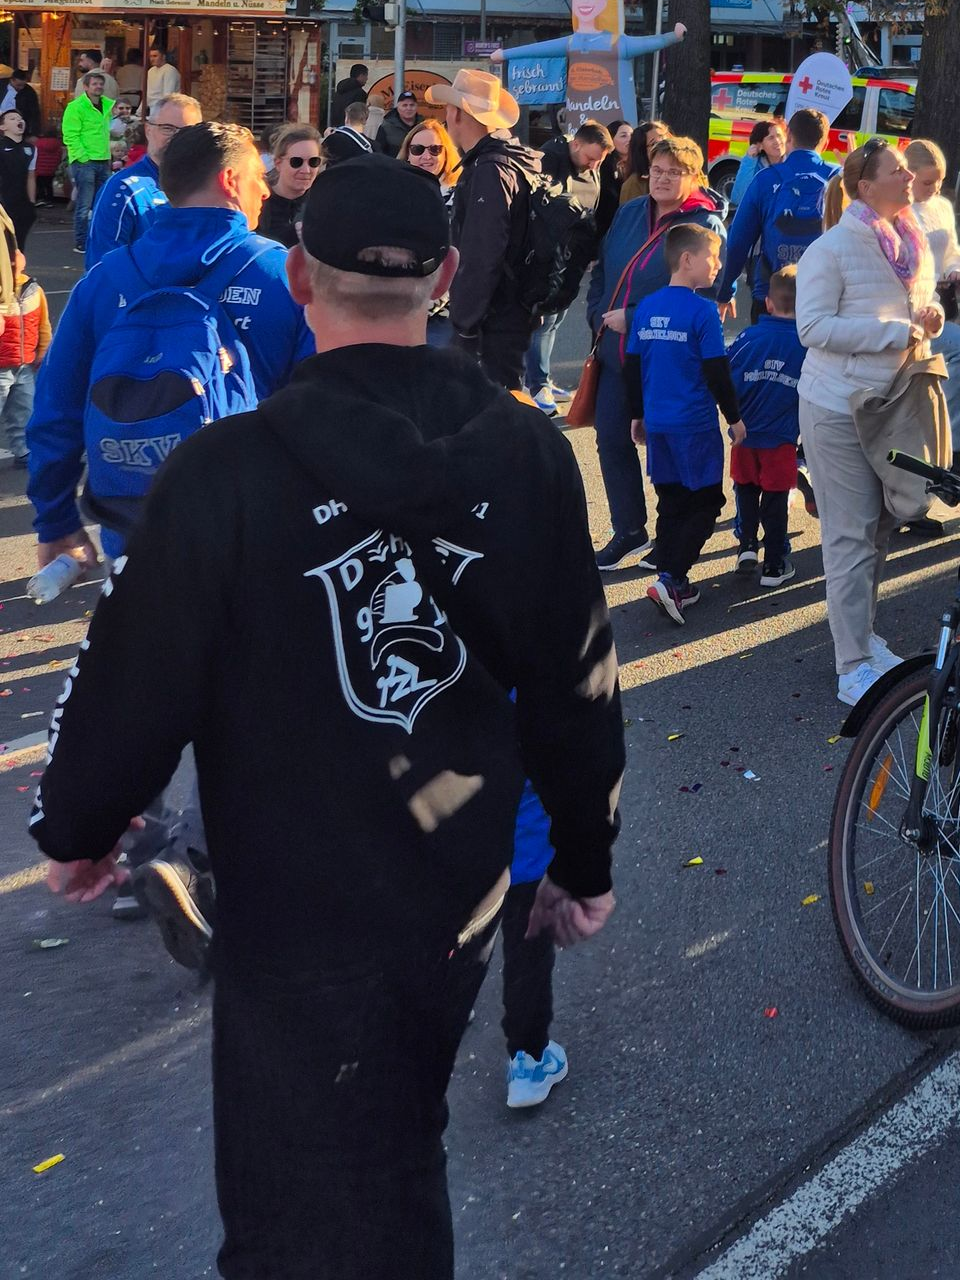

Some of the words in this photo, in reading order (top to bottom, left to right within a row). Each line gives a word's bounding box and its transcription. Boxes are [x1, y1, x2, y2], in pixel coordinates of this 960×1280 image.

[197, 0, 231, 8] Mandeln
[240, 0, 264, 9] Nüsse
[511, 63, 545, 80] frisch
[816, 79, 845, 92] Deutsches
[737, 89, 776, 99] Deutsches
[736, 98, 757, 106] Rotes
[100, 433, 181, 466] SKV
